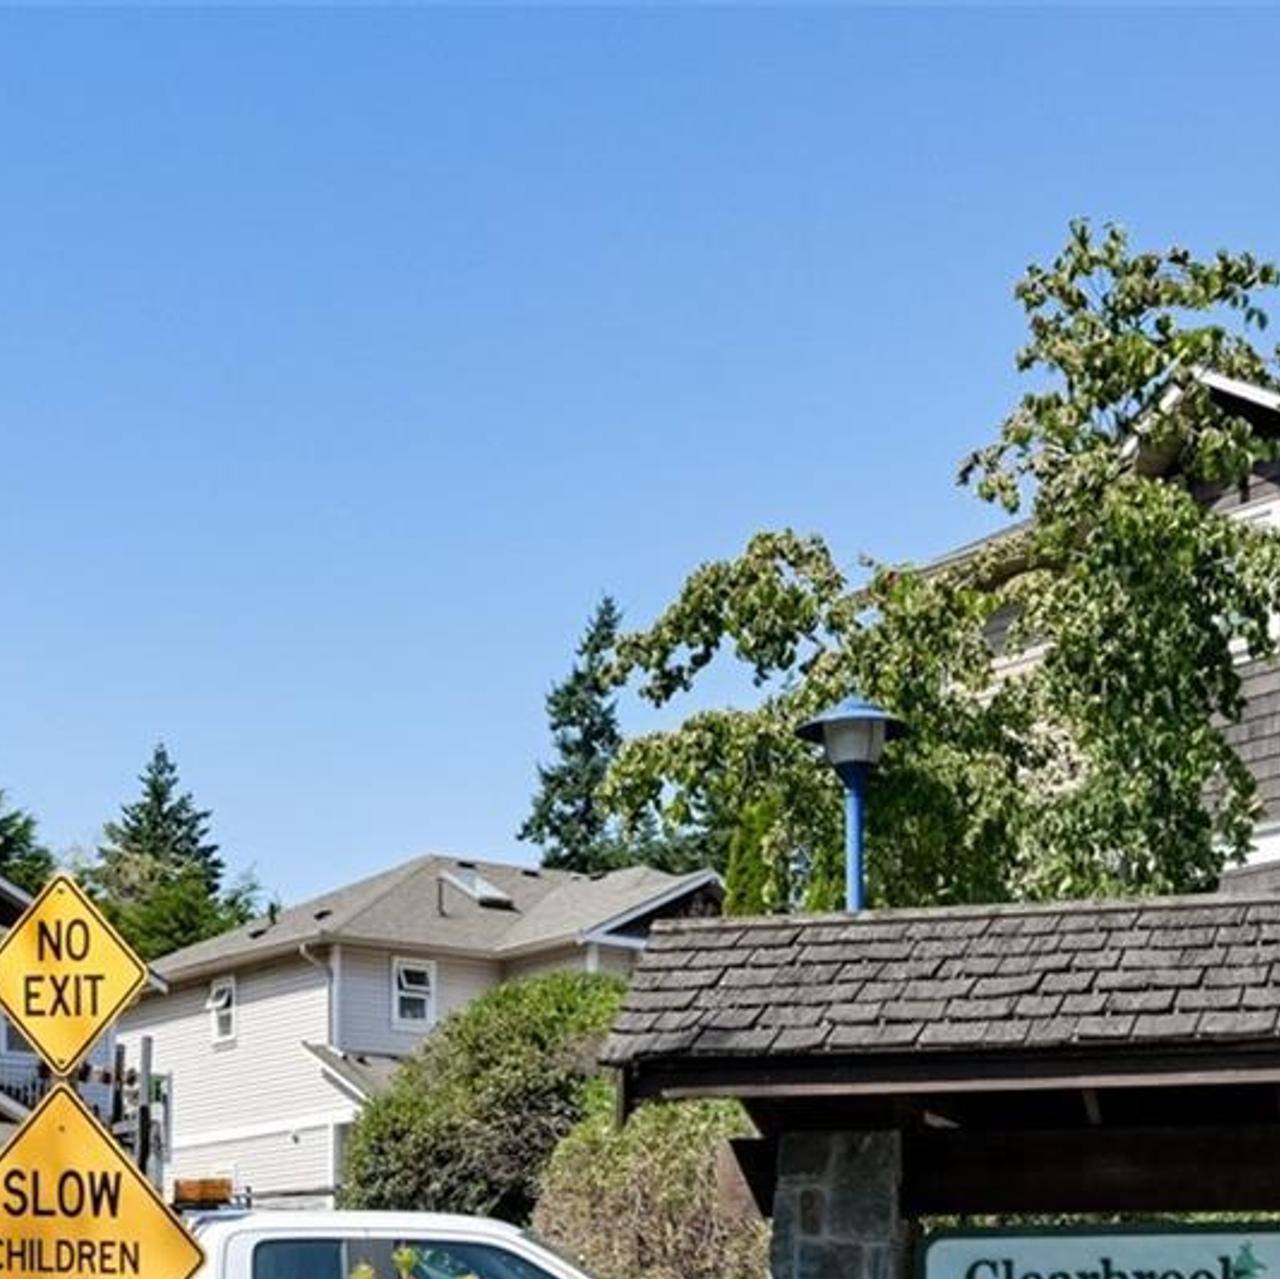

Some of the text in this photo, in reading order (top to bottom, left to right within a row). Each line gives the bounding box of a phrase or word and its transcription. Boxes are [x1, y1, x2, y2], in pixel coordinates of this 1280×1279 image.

[36, 918, 90, 962] NO
[24, 974, 105, 1018] EXIT
[2, 1169, 121, 1219] SLOW
